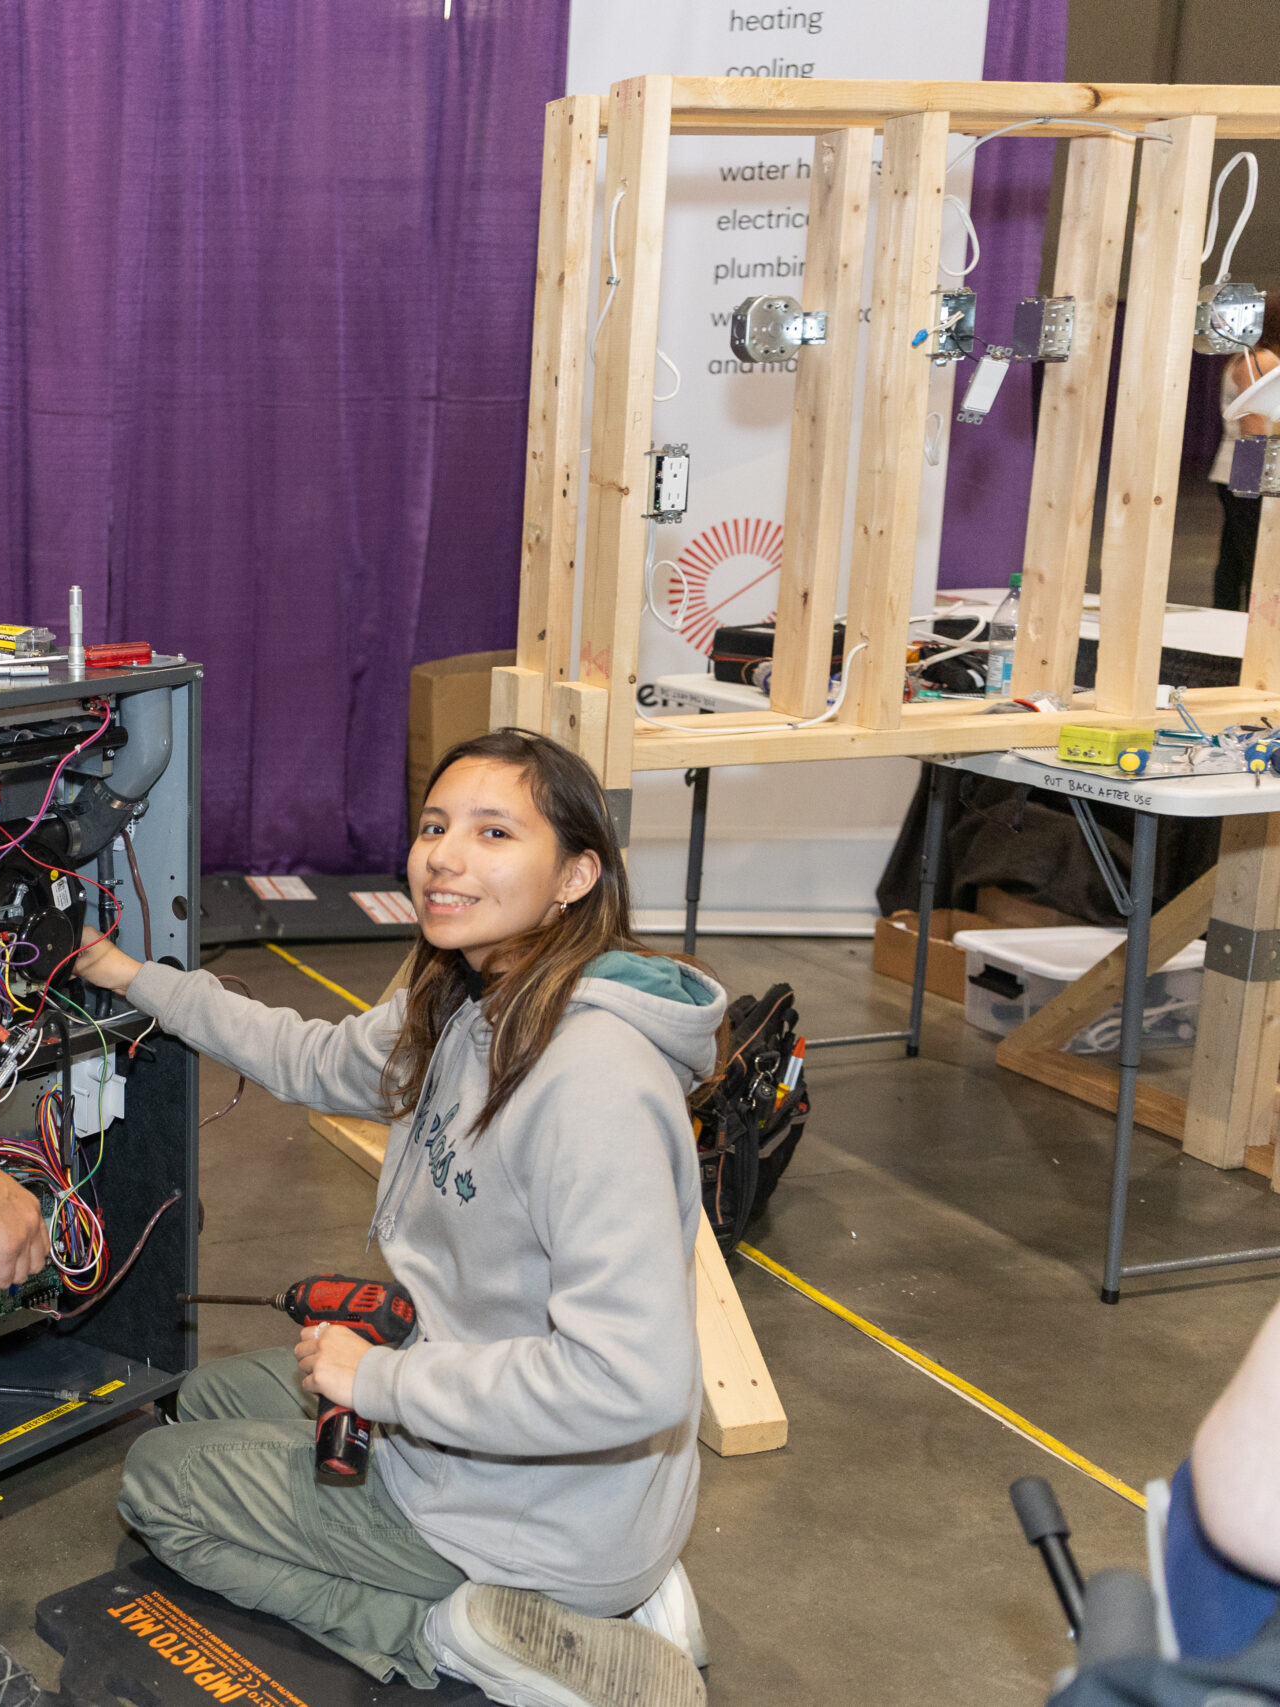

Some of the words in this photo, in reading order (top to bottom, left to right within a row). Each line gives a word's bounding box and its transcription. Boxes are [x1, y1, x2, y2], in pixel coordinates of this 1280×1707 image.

[729, 6, 824, 35] heating
[726, 57, 815, 79] cooling
[720, 160, 790, 182] water
[1044, 775, 1063, 787] PUT
[1068, 779, 1094, 794] BACK
[1098, 787, 1130, 801] AFTER
[1134, 795, 1152, 806] USE
[106, 1602, 164, 1637] MAT
[148, 1631, 248, 1703] IMPACTO
